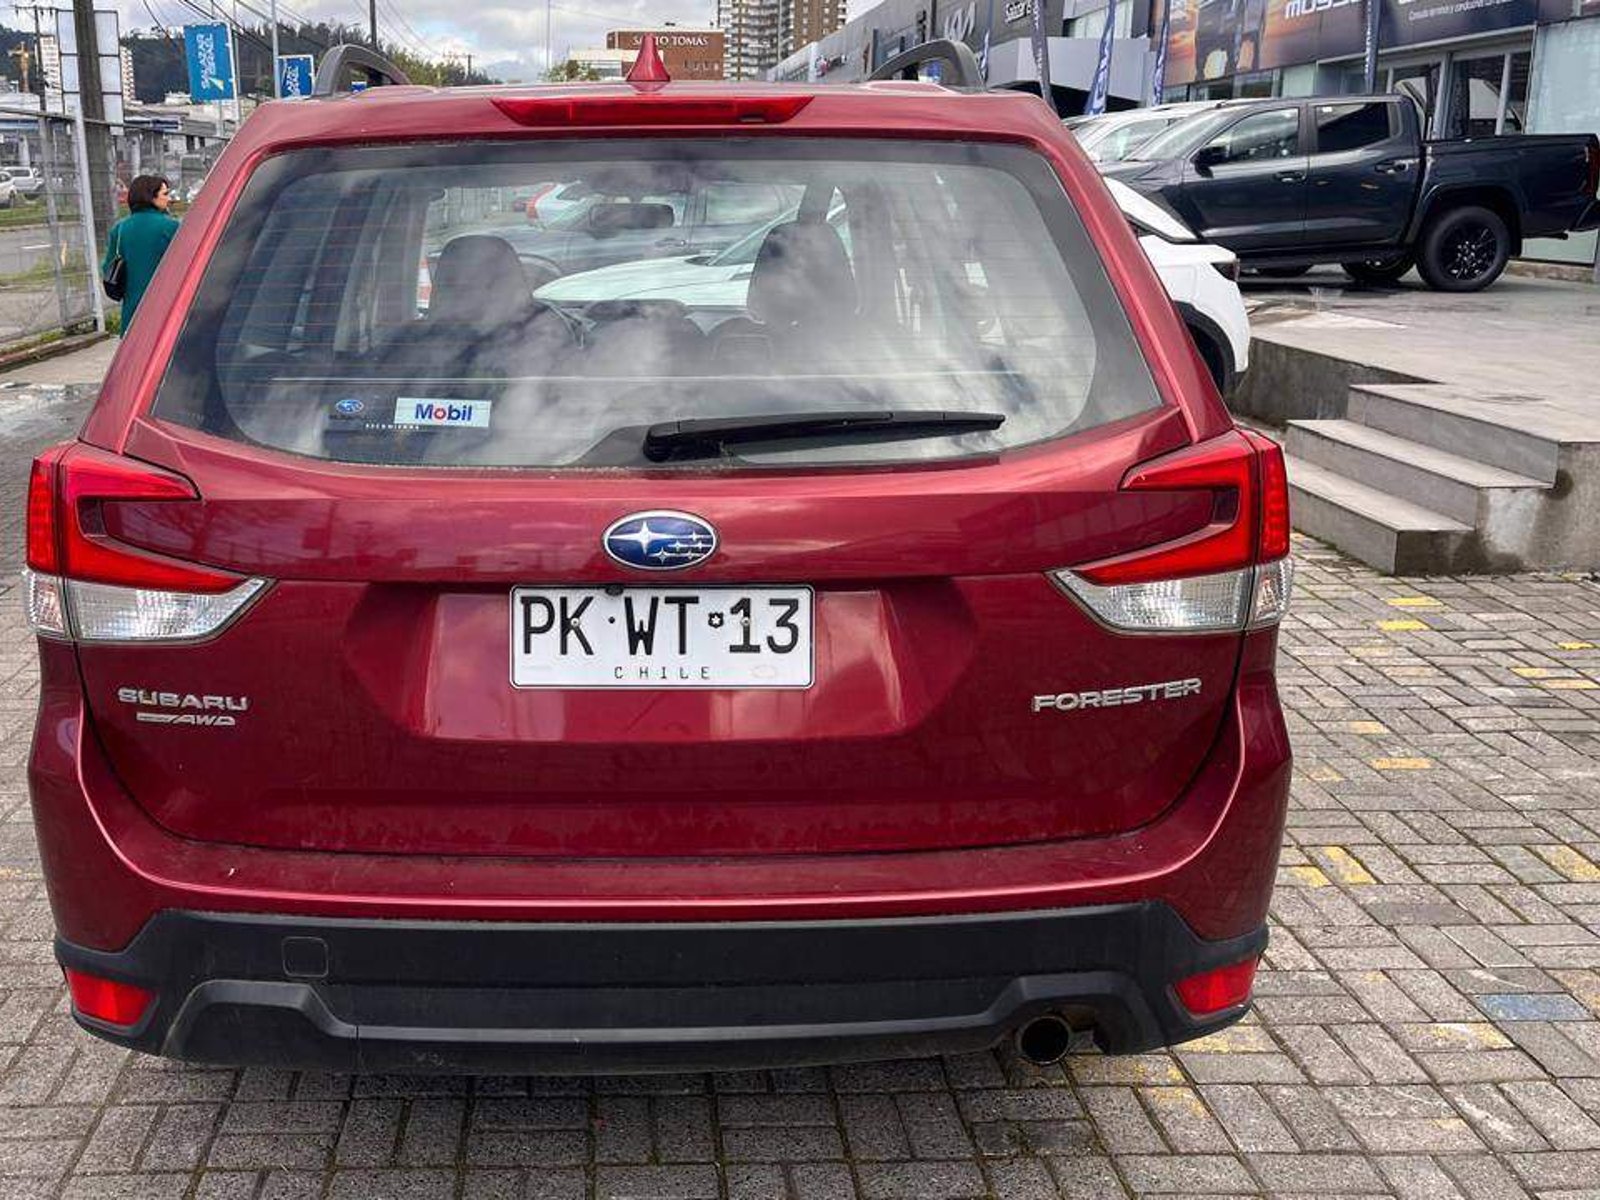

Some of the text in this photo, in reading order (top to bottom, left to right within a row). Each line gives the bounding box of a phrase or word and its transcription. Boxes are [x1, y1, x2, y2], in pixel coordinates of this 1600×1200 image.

[415, 403, 472, 422] Mobil
[614, 667, 711, 680] CHILE
[118, 687, 248, 711] SUBARU
[1033, 677, 1201, 712] FORESTER
[172, 714, 236, 726] AWD
